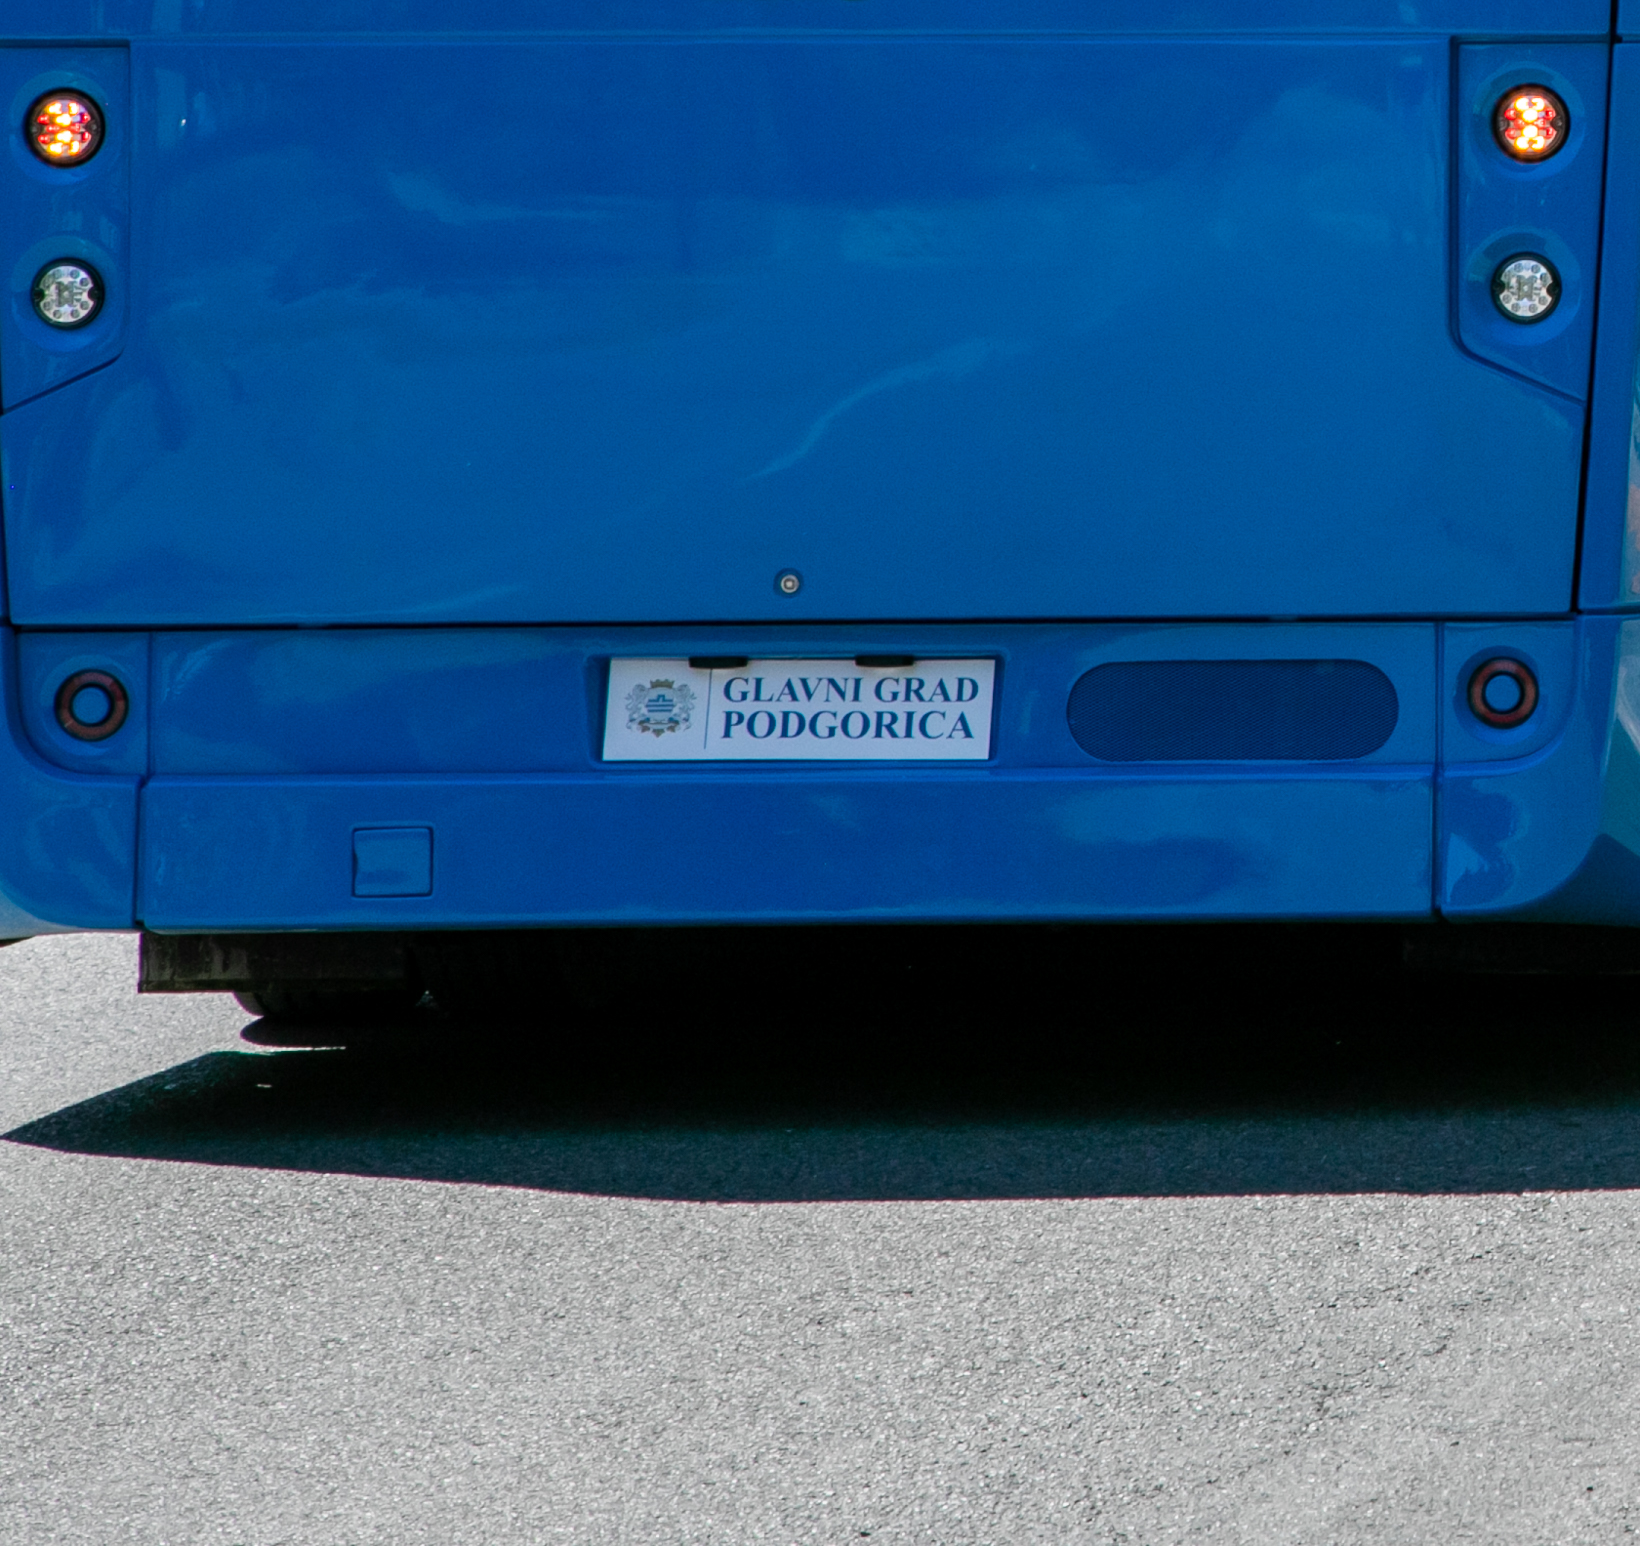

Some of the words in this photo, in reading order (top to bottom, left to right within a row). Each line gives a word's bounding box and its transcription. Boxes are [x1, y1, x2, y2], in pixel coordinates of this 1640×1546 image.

[722, 675, 864, 704] GLAVNI
[873, 675, 980, 704] GRAD
[721, 709, 975, 741] PODGORICA
